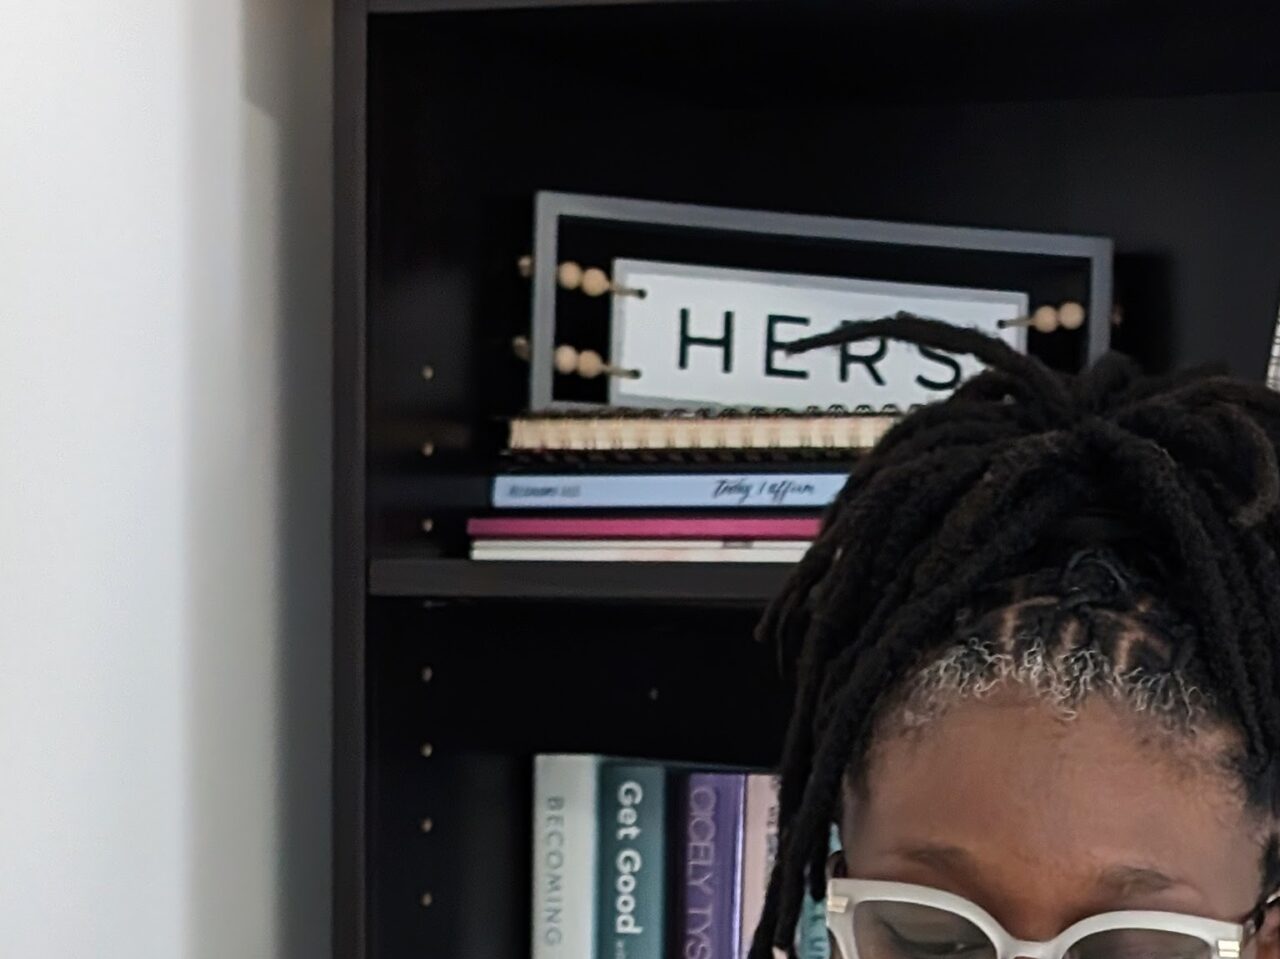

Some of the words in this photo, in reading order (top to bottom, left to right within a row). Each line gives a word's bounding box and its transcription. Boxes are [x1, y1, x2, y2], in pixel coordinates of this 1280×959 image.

[677, 306, 961, 391] HERS
[616, 780, 644, 842] Get
[685, 785, 717, 900] CICELY
[544, 795, 566, 949] BECOMING
[614, 848, 642, 935] Good
